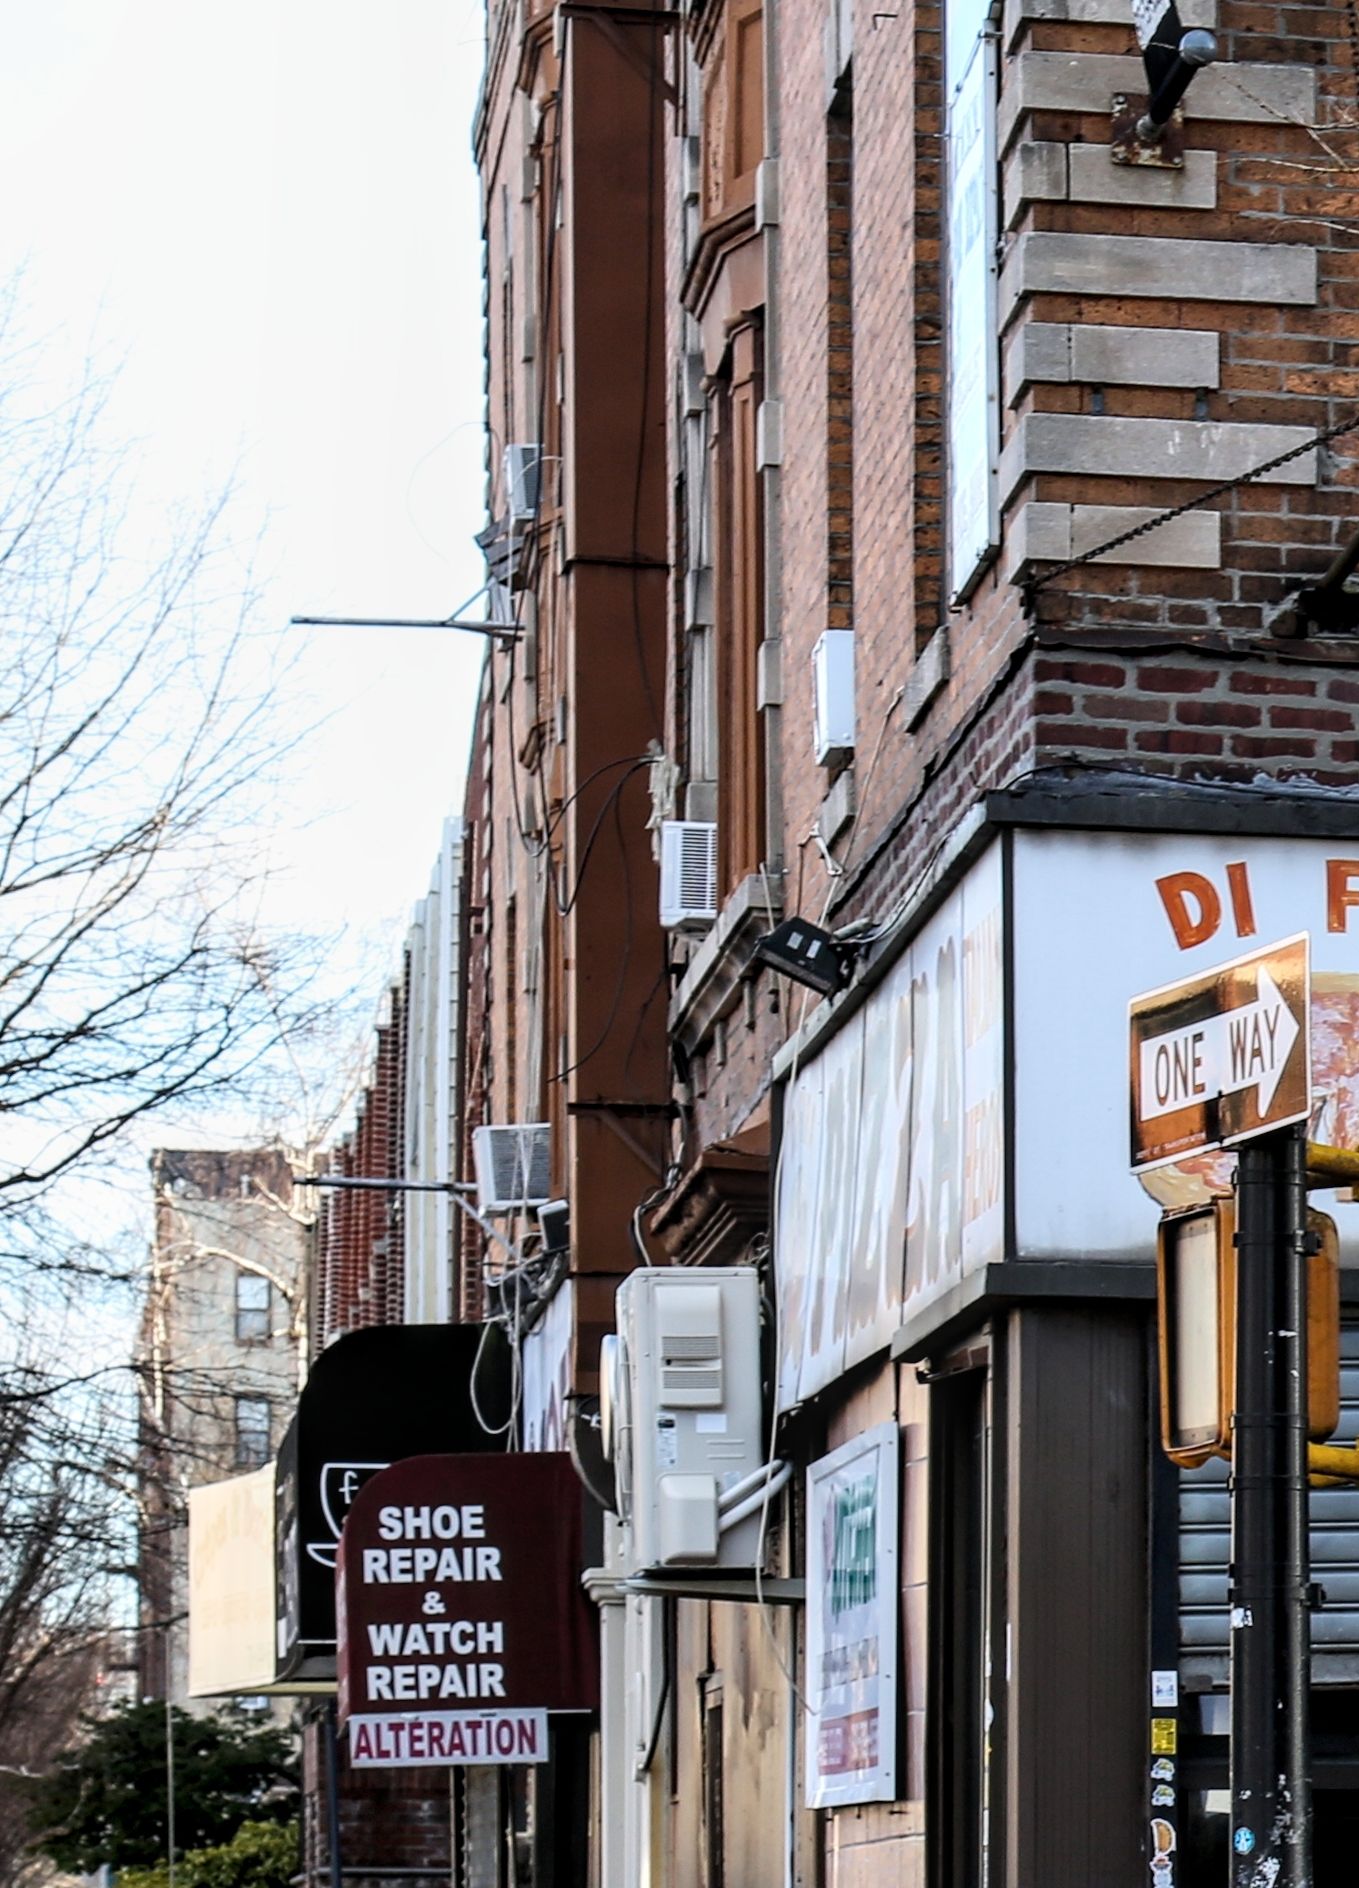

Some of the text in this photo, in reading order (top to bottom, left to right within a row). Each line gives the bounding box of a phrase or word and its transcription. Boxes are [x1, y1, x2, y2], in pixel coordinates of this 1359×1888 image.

[1155, 861, 1256, 951] DI
[1155, 1003, 1281, 1106] ONE WAY
[378, 1505, 486, 1540] SHOE
[363, 1547, 503, 1584] REPAIR
[422, 1591, 446, 1615] &
[367, 1621, 504, 1657] WATCH
[366, 1663, 506, 1701] REPAIR
[354, 1718, 537, 1760] ALTERATION
